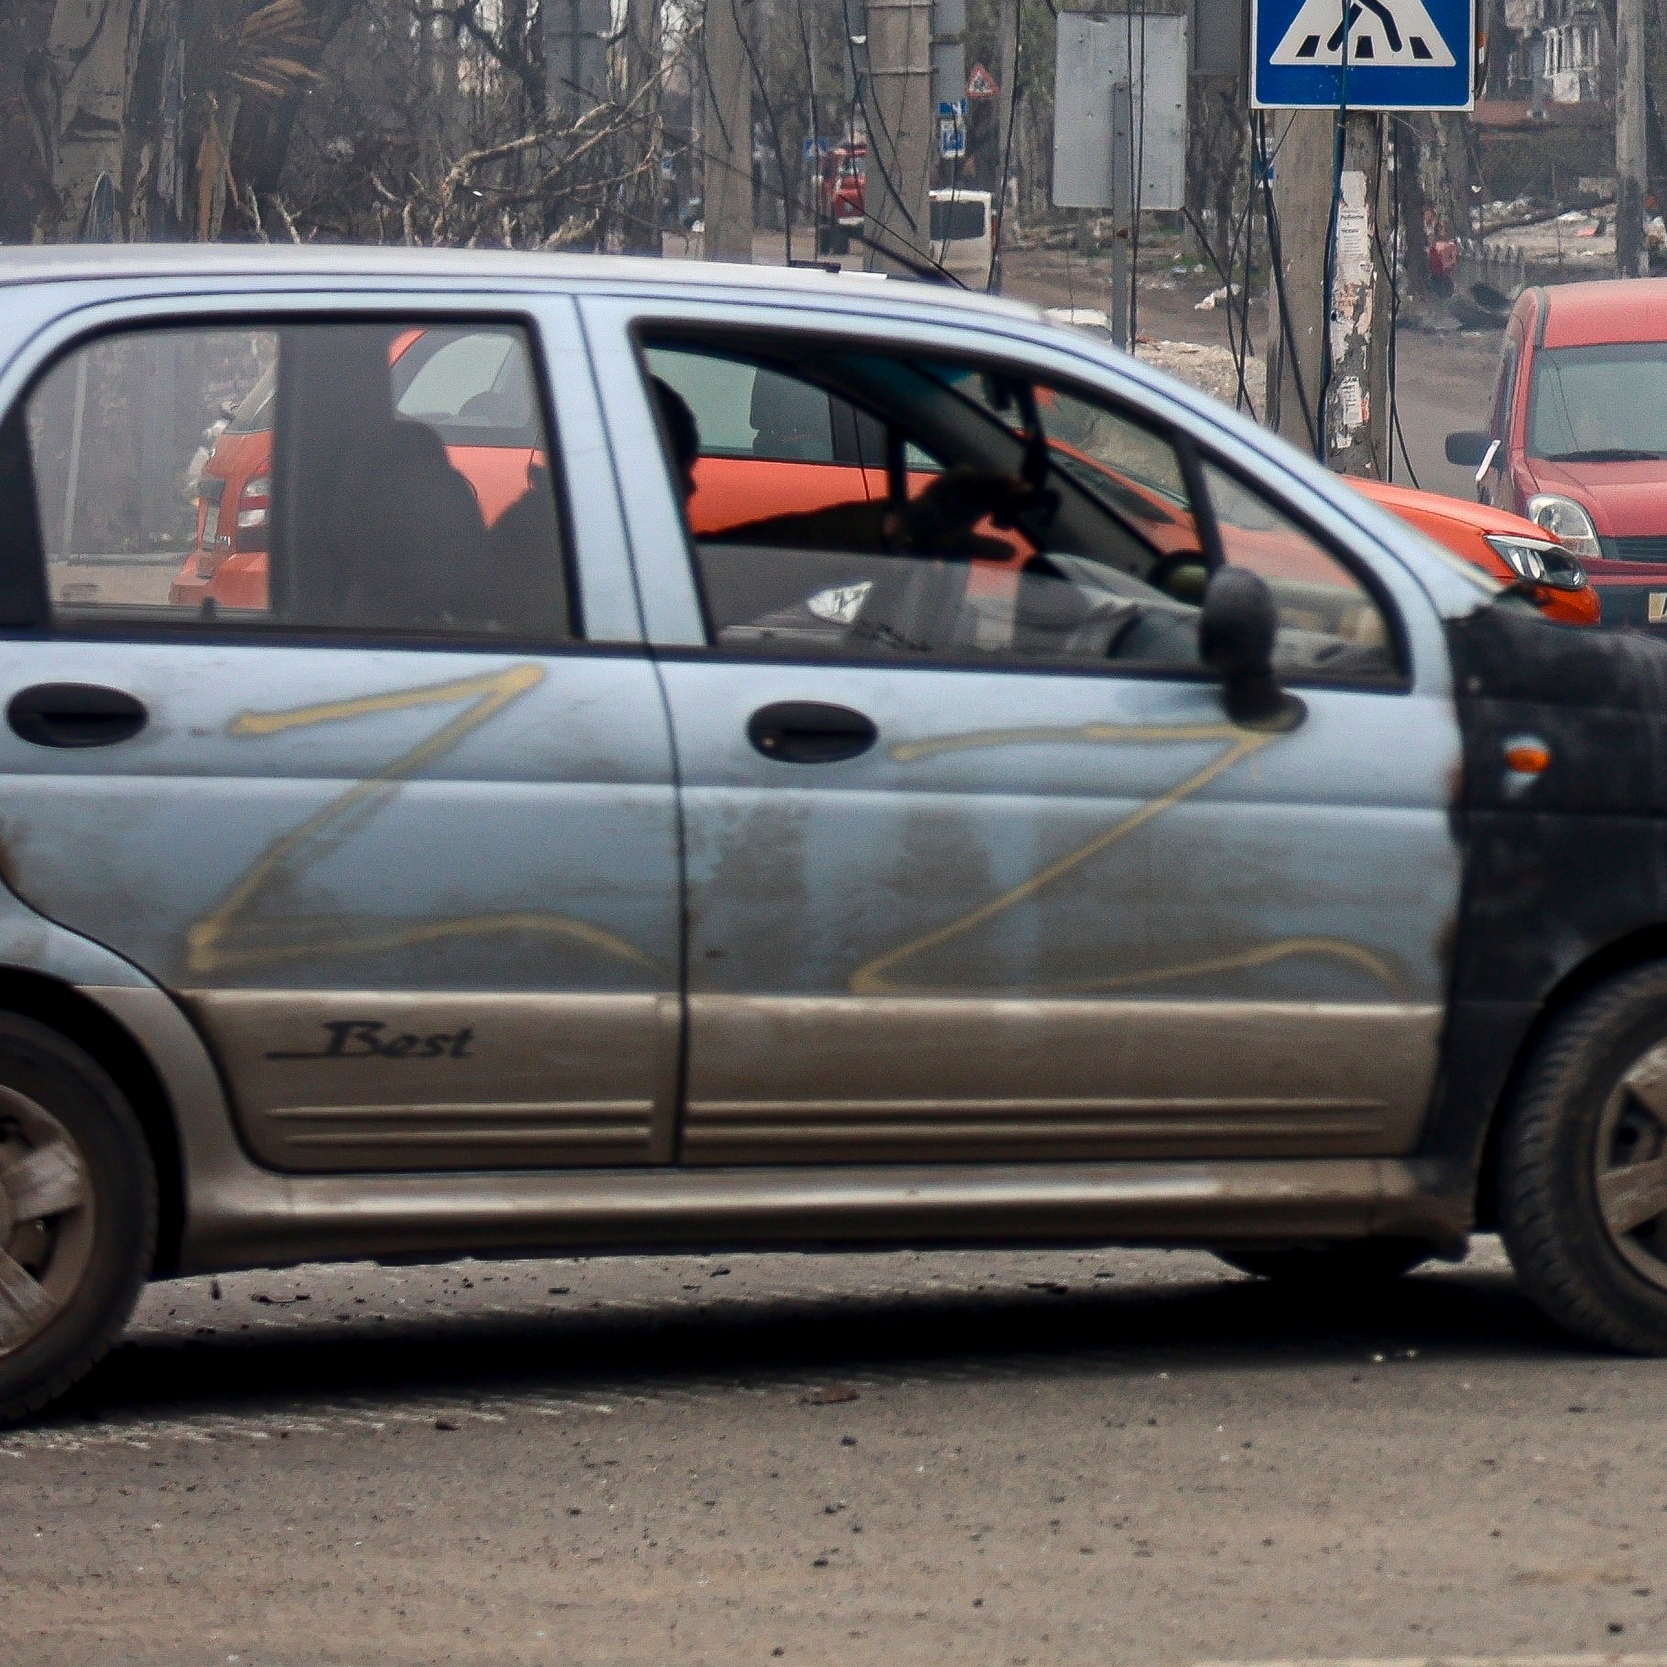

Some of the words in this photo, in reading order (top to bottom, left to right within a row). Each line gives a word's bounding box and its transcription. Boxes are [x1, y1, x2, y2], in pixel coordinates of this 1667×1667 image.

[188, 663, 664, 973] Z
[850, 721, 1398, 995] Z
[266, 1020, 475, 1060] Best
